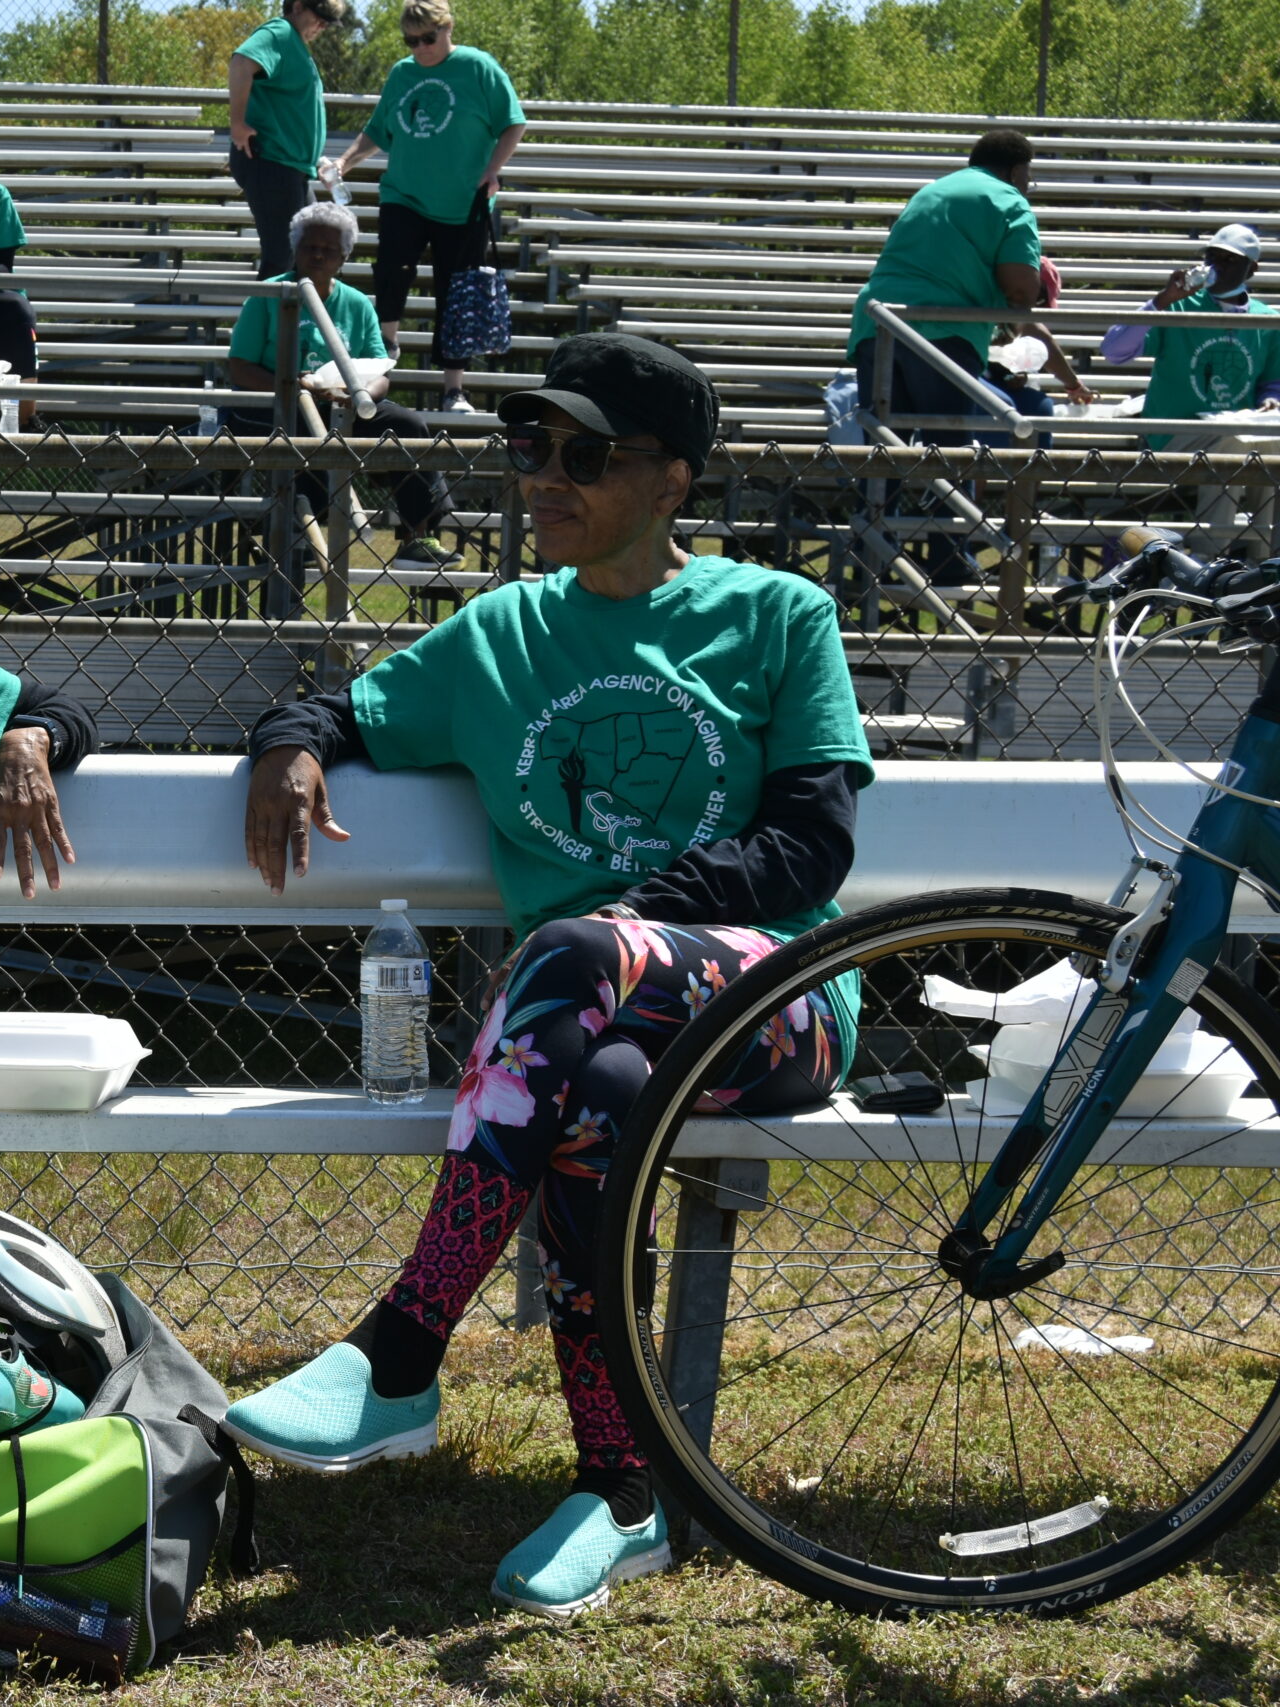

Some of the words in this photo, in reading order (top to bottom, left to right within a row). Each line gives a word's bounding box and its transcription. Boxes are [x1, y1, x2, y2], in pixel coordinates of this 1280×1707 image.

[515, 708, 553, 777] KERR-TAR
[551, 683, 589, 711] AREA
[589, 674, 667, 696] AGENCY
[666, 685, 696, 713] ON
[688, 709, 727, 768] AGING
[519, 800, 593, 862] STRONGER
[608, 821, 671, 858] Games
[1082, 1068, 1106, 1099] HCM
[638, 1324, 669, 1409] BONTRAGER
[1183, 1450, 1252, 1520] BONTRAGER
